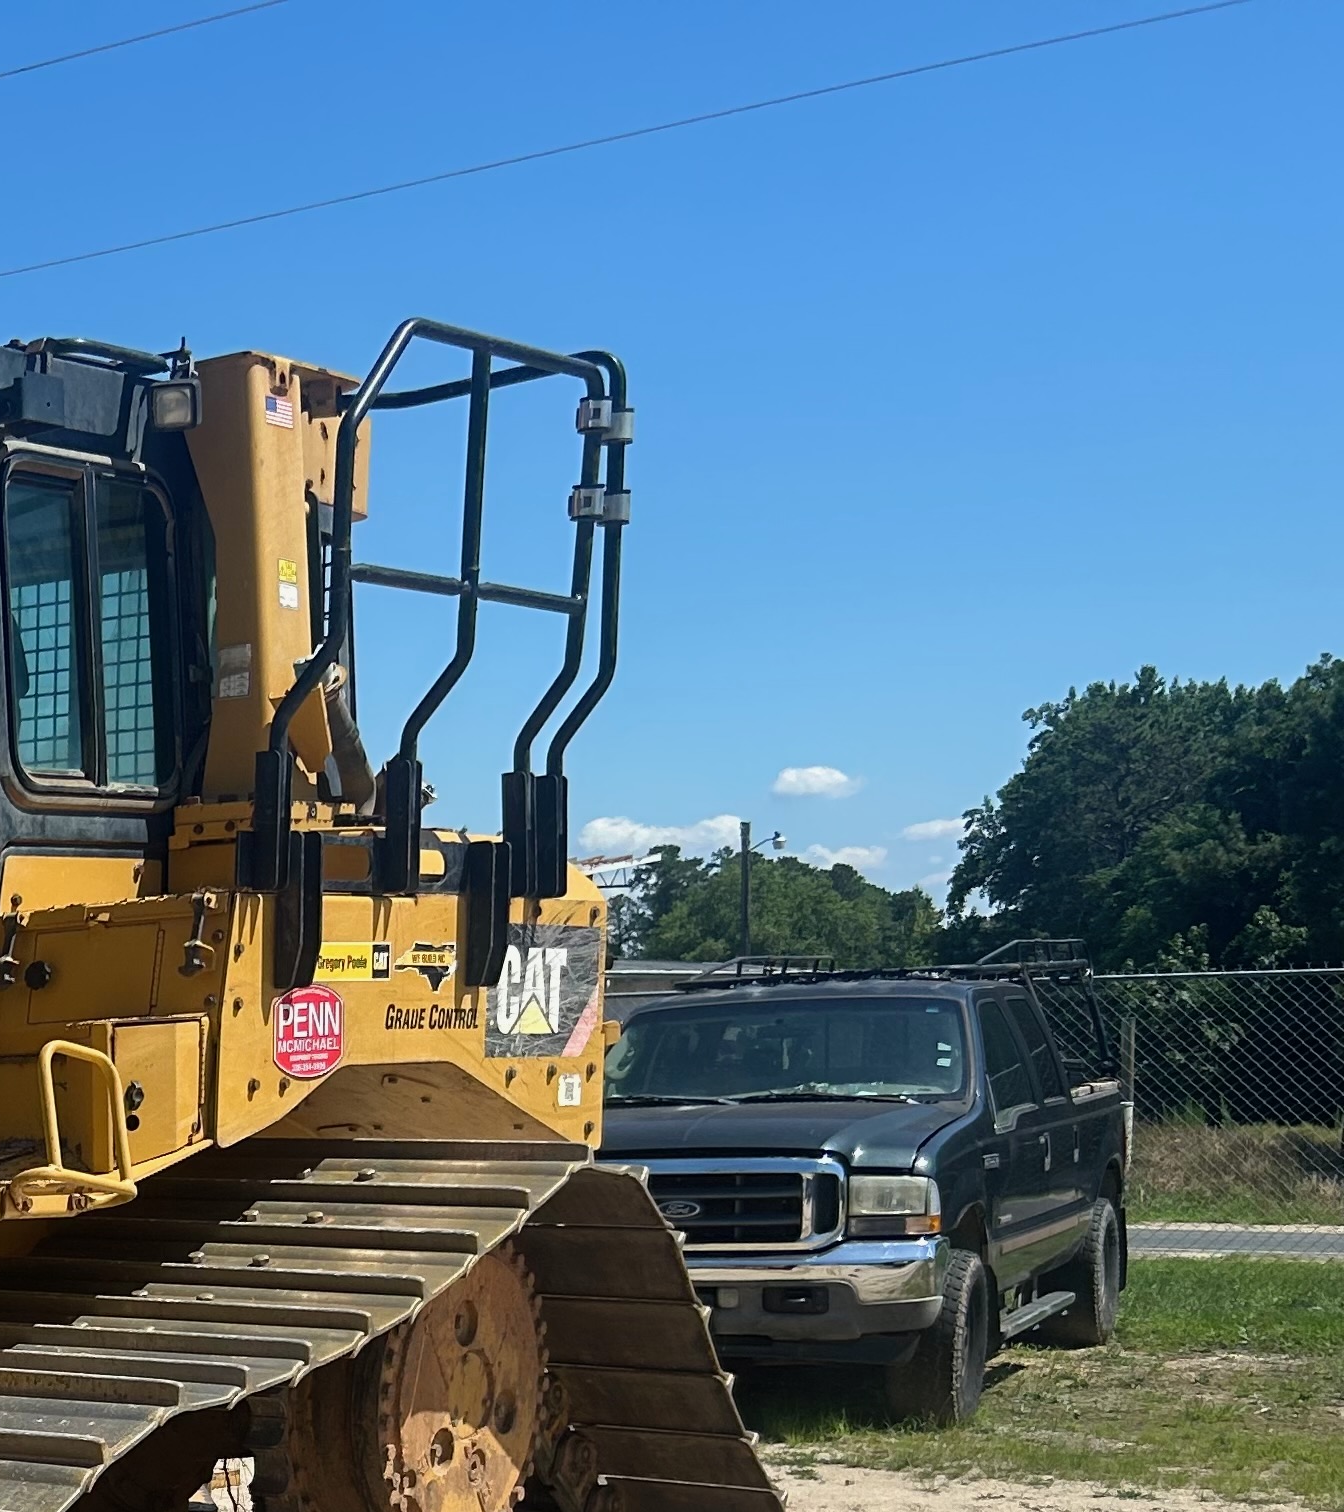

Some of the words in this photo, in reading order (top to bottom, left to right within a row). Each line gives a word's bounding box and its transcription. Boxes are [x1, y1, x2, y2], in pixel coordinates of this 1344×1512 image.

[317, 955, 346, 973] Gregory
[496, 944, 568, 1035] CAT
[278, 1001, 340, 1039] PENN
[428, 1004, 479, 1030] CONTROL
